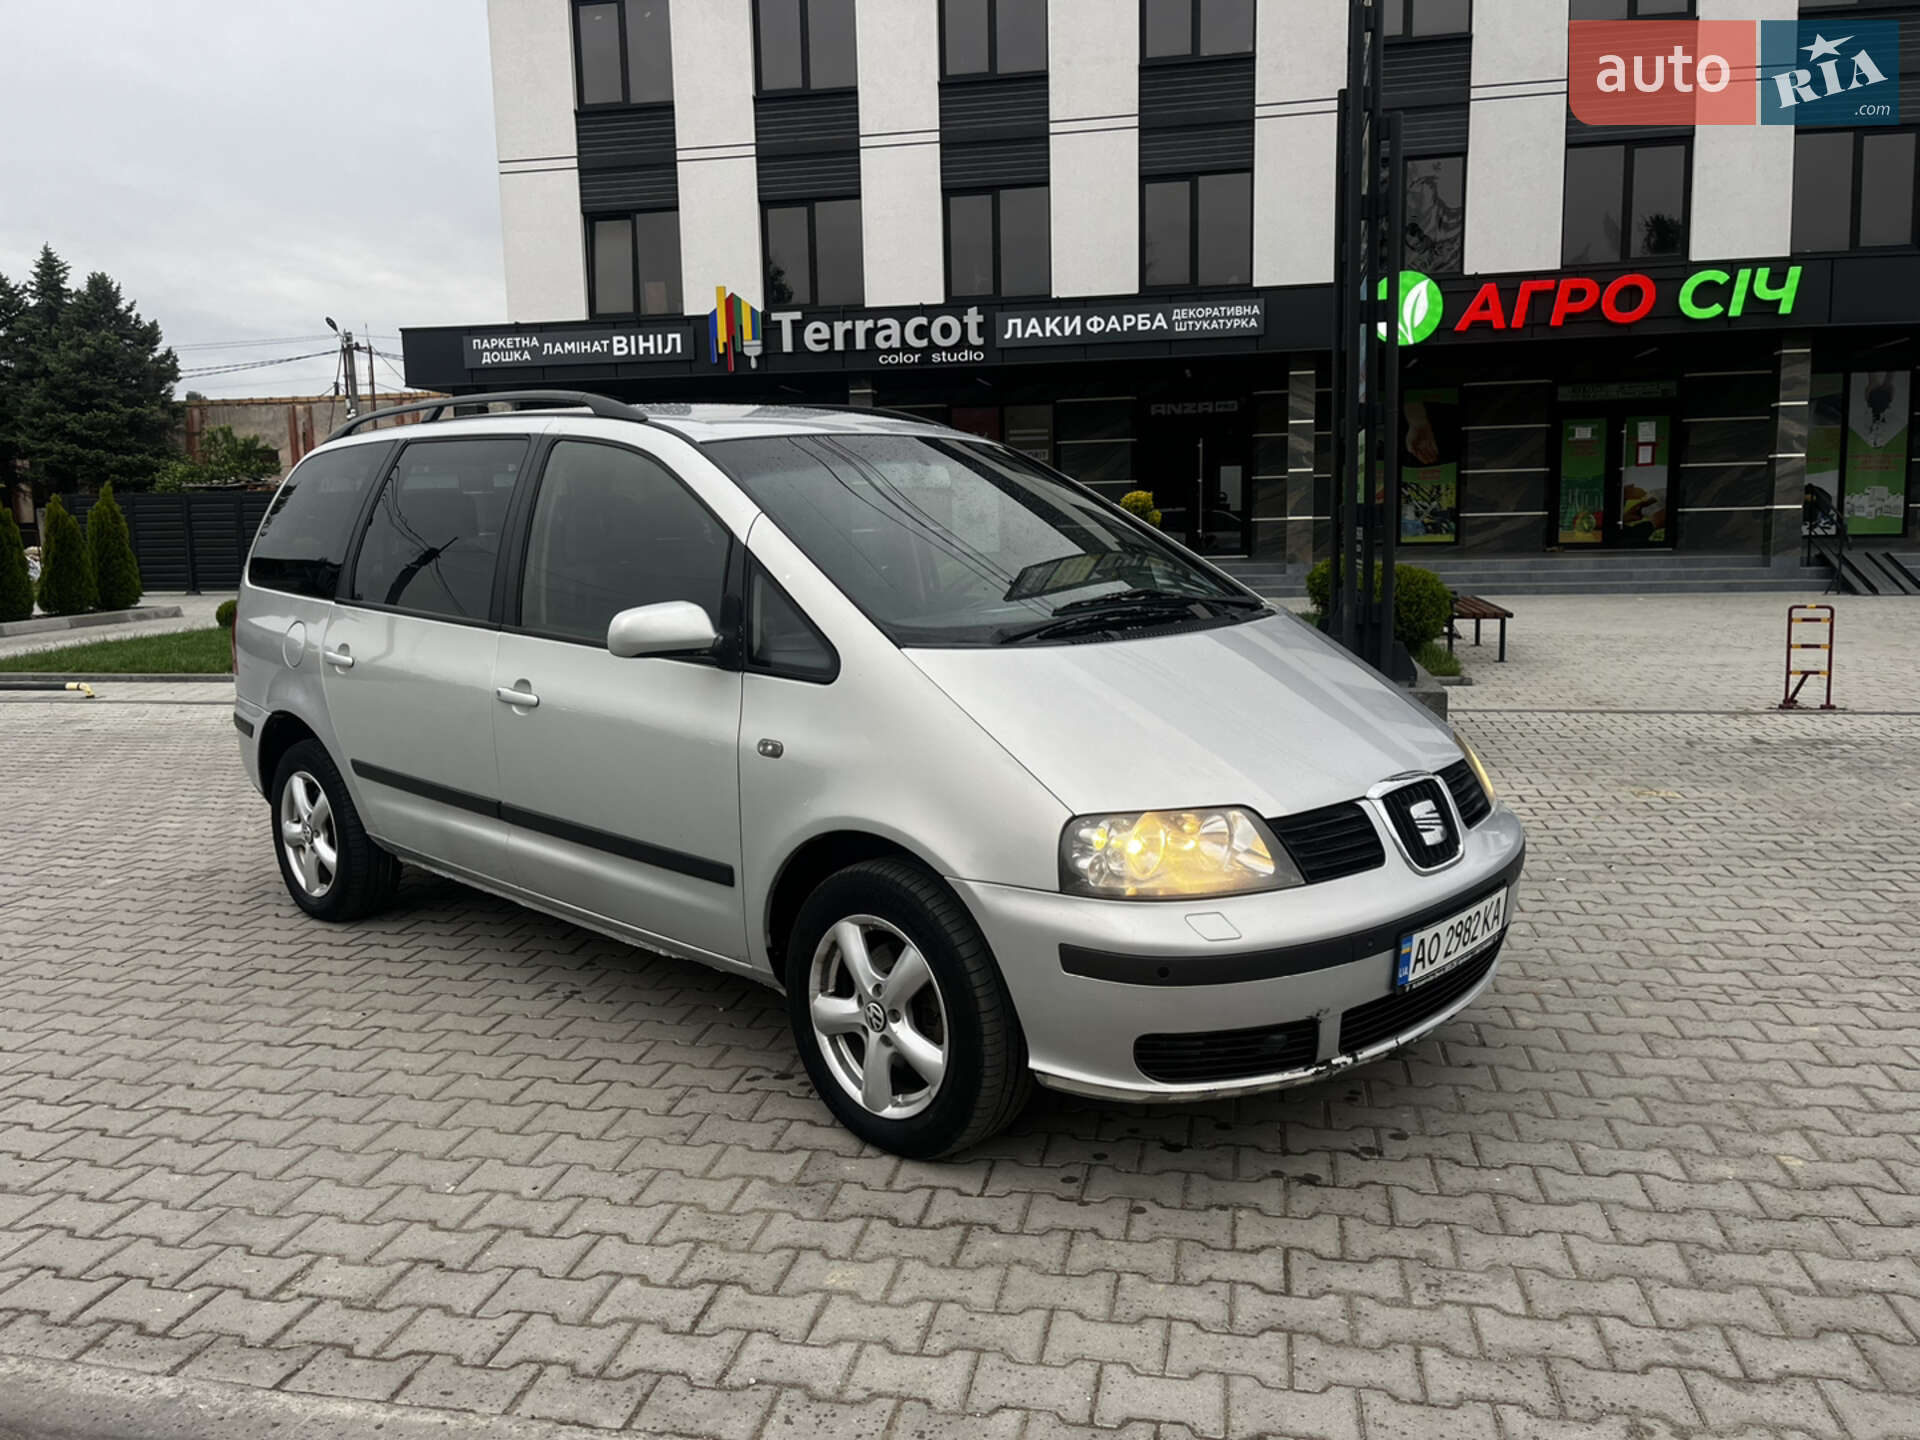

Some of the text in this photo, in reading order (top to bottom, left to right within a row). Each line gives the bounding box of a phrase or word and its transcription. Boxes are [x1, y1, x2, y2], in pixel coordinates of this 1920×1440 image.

[1453, 266, 1802, 332] АГРО СІЧ
[1172, 304, 1261, 321] ДЕКОРАТИВНА
[771, 306, 985, 353] Terracot
[1003, 312, 1168, 339] ЛАКИ ФАРБА
[1174, 317, 1258, 332] ШТУКАТУРКА
[472, 336, 540, 351] ПАРКЕТНА
[542, 333, 682, 356] ЛАМІНАТ ВІНІЛ
[481, 349, 532, 365] ДОШКА
[878, 349, 985, 365] color studio
[1411, 931, 1441, 974] AO
[1443, 910, 1480, 959] 2982
[1481, 897, 1503, 937] KA
